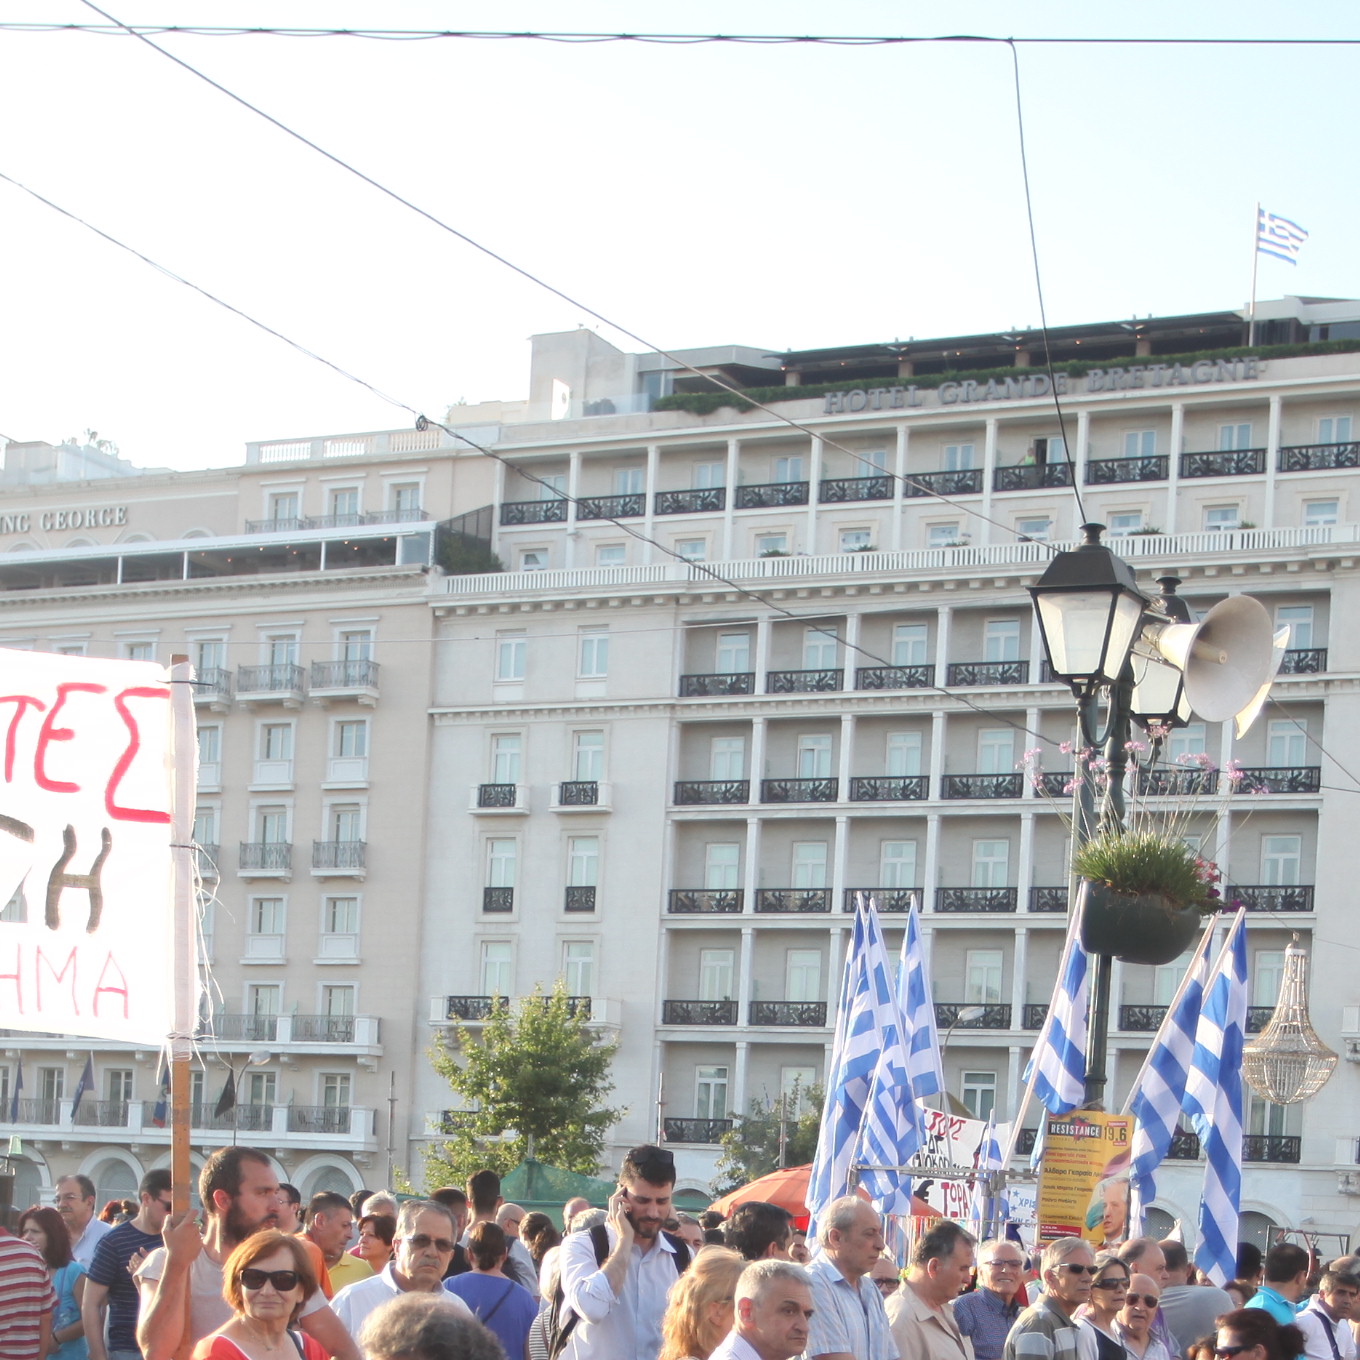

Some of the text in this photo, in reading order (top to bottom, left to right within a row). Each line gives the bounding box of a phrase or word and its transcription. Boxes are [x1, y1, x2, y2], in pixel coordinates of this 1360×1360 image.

[823, 355, 1262, 414] HOTEL GRANDE BRETAGNE
[39, 506, 129, 533] GEORGE
[1050, 1123, 1100, 1137] RESISTANCE
[1104, 1126, 1127, 1142] 19.6
